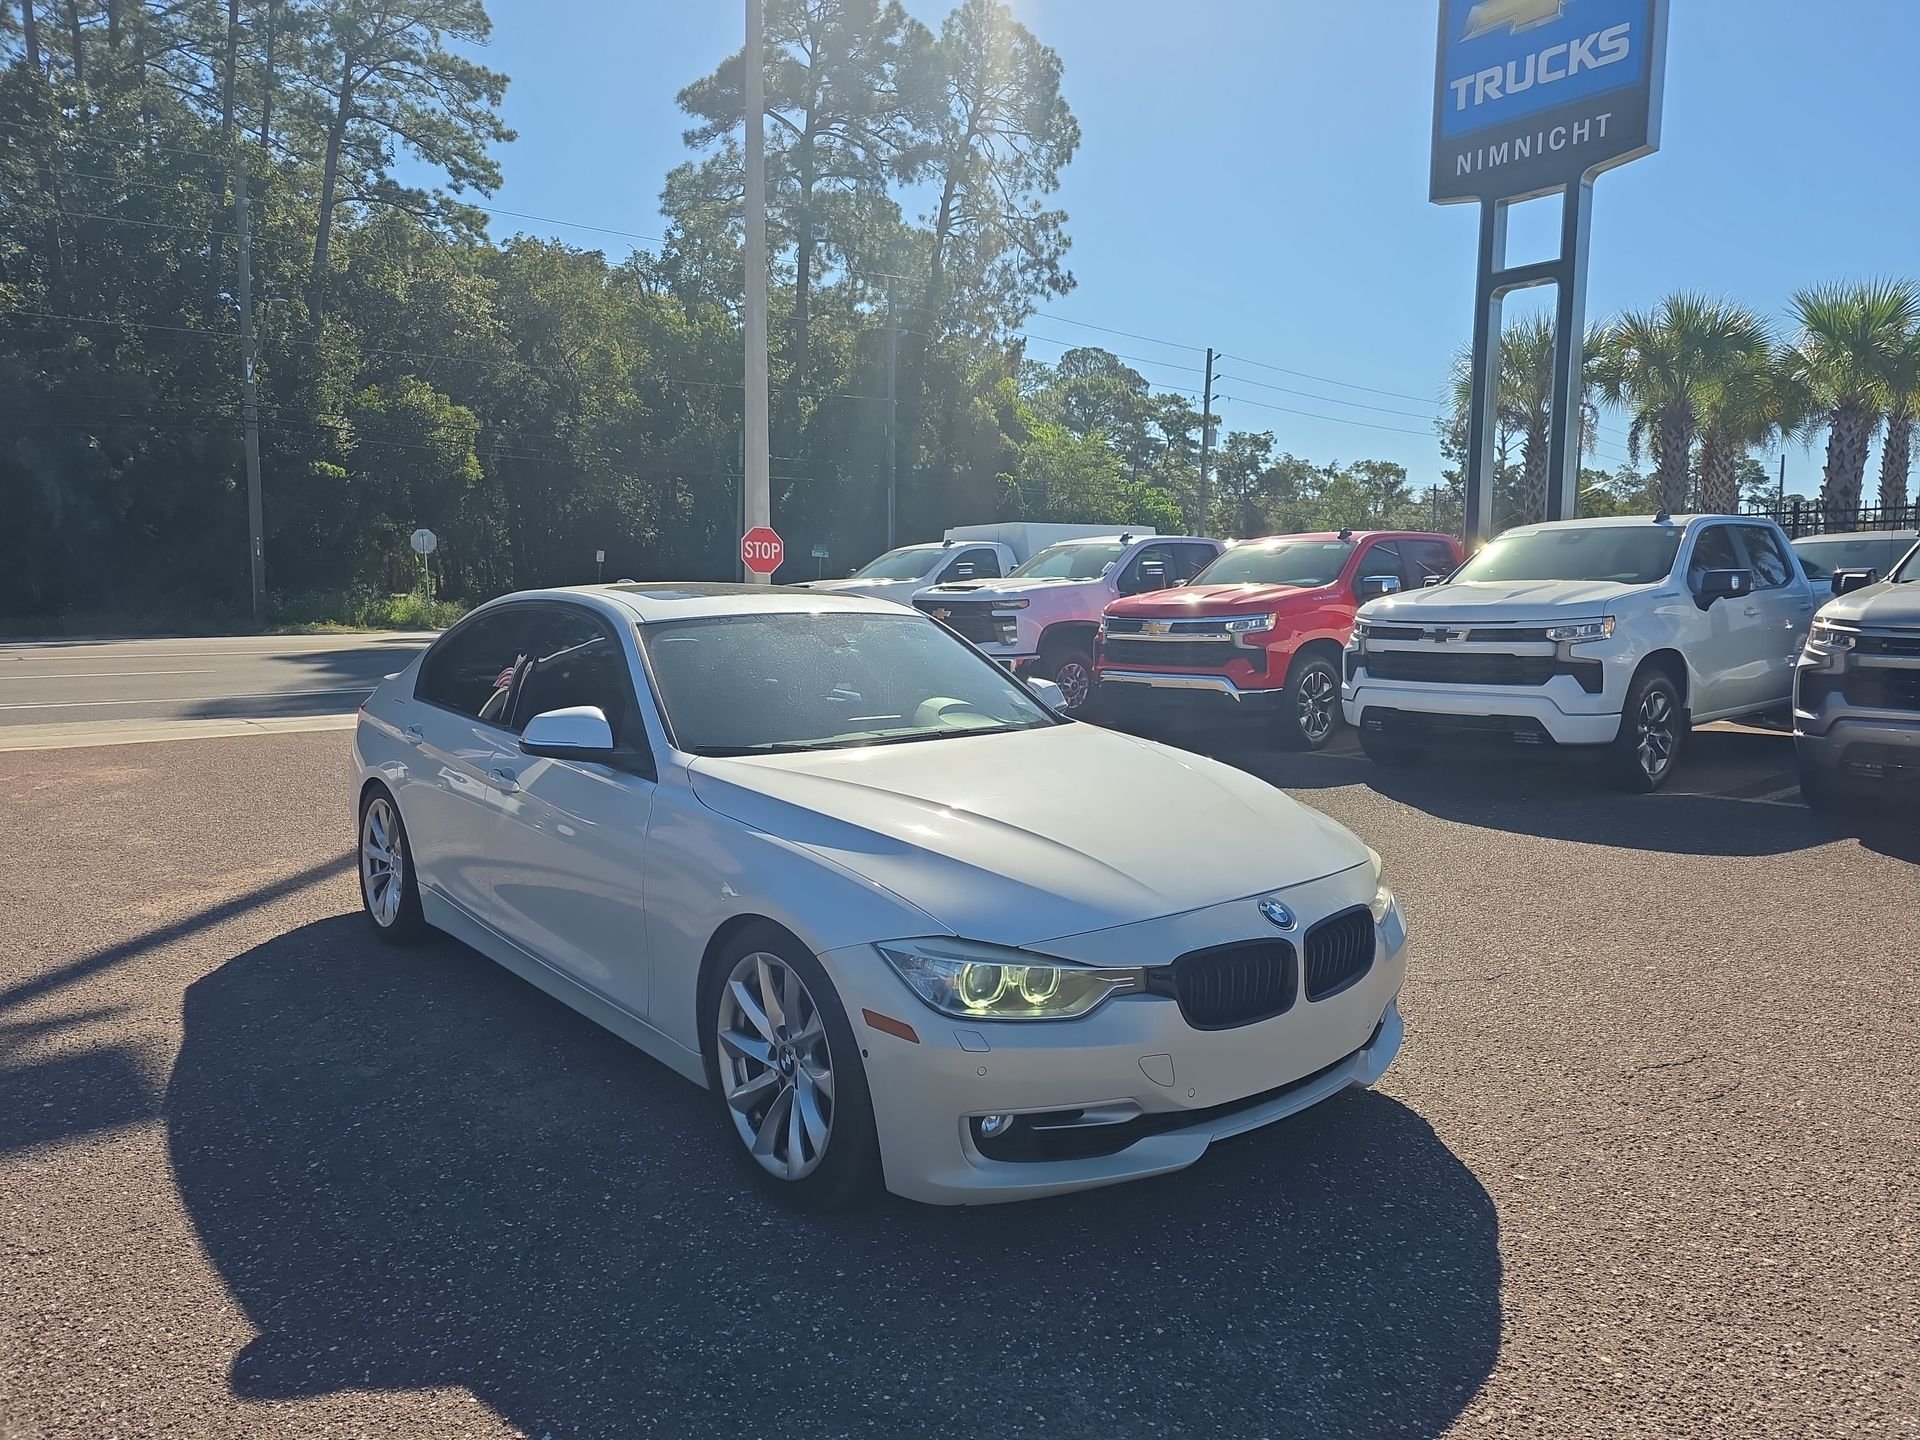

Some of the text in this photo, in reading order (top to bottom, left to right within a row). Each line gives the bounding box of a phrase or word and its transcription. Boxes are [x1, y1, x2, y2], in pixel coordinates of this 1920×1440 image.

[1450, 22, 1630, 111] TRUCKS
[1456, 112, 1612, 176] NIMNICHT
[744, 541, 780, 560] STOP
